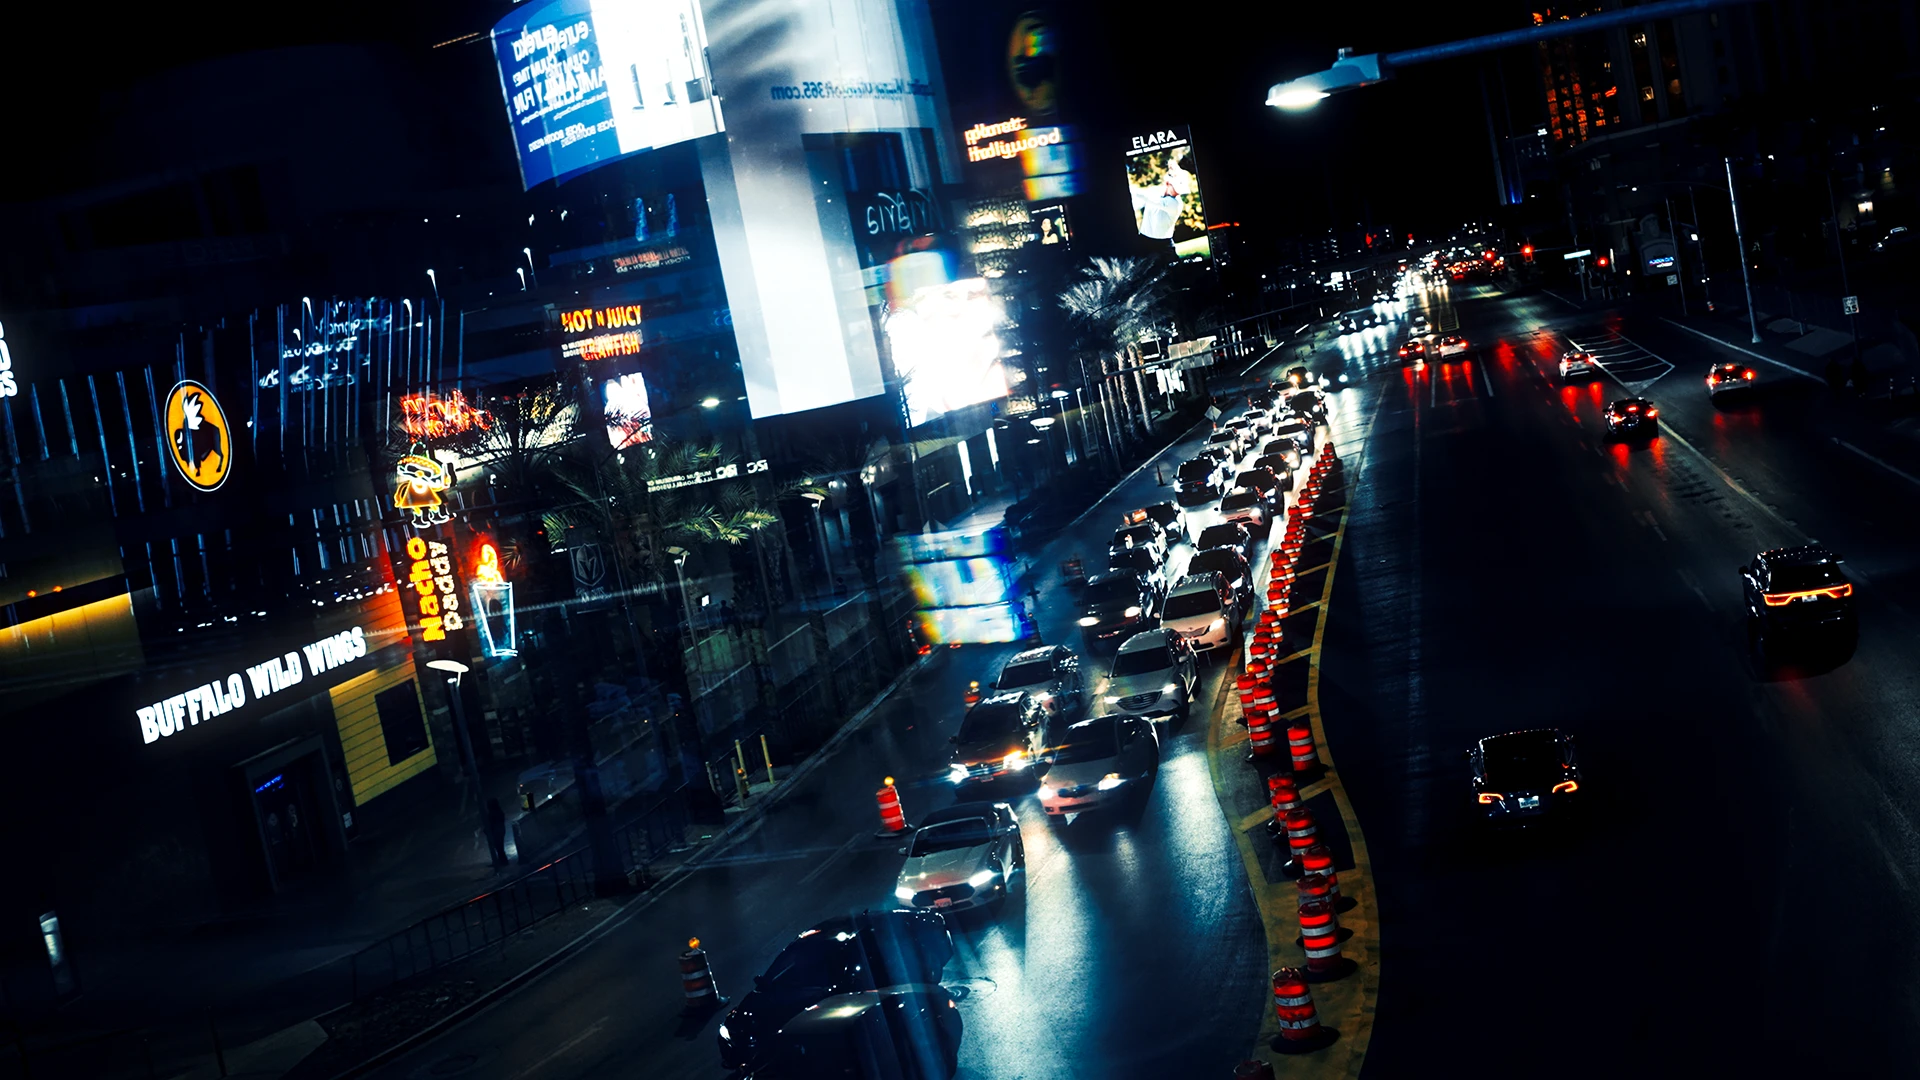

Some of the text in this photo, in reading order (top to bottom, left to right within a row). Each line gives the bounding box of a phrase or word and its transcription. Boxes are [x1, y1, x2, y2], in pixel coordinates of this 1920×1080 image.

[1131, 129, 1178, 149] ELARA
[560, 308, 593, 333] HOT
[605, 304, 642, 329] JUICY
[406, 536, 446, 642] Nacho
[136, 625, 367, 745] BUFFALO WILD WINGS
